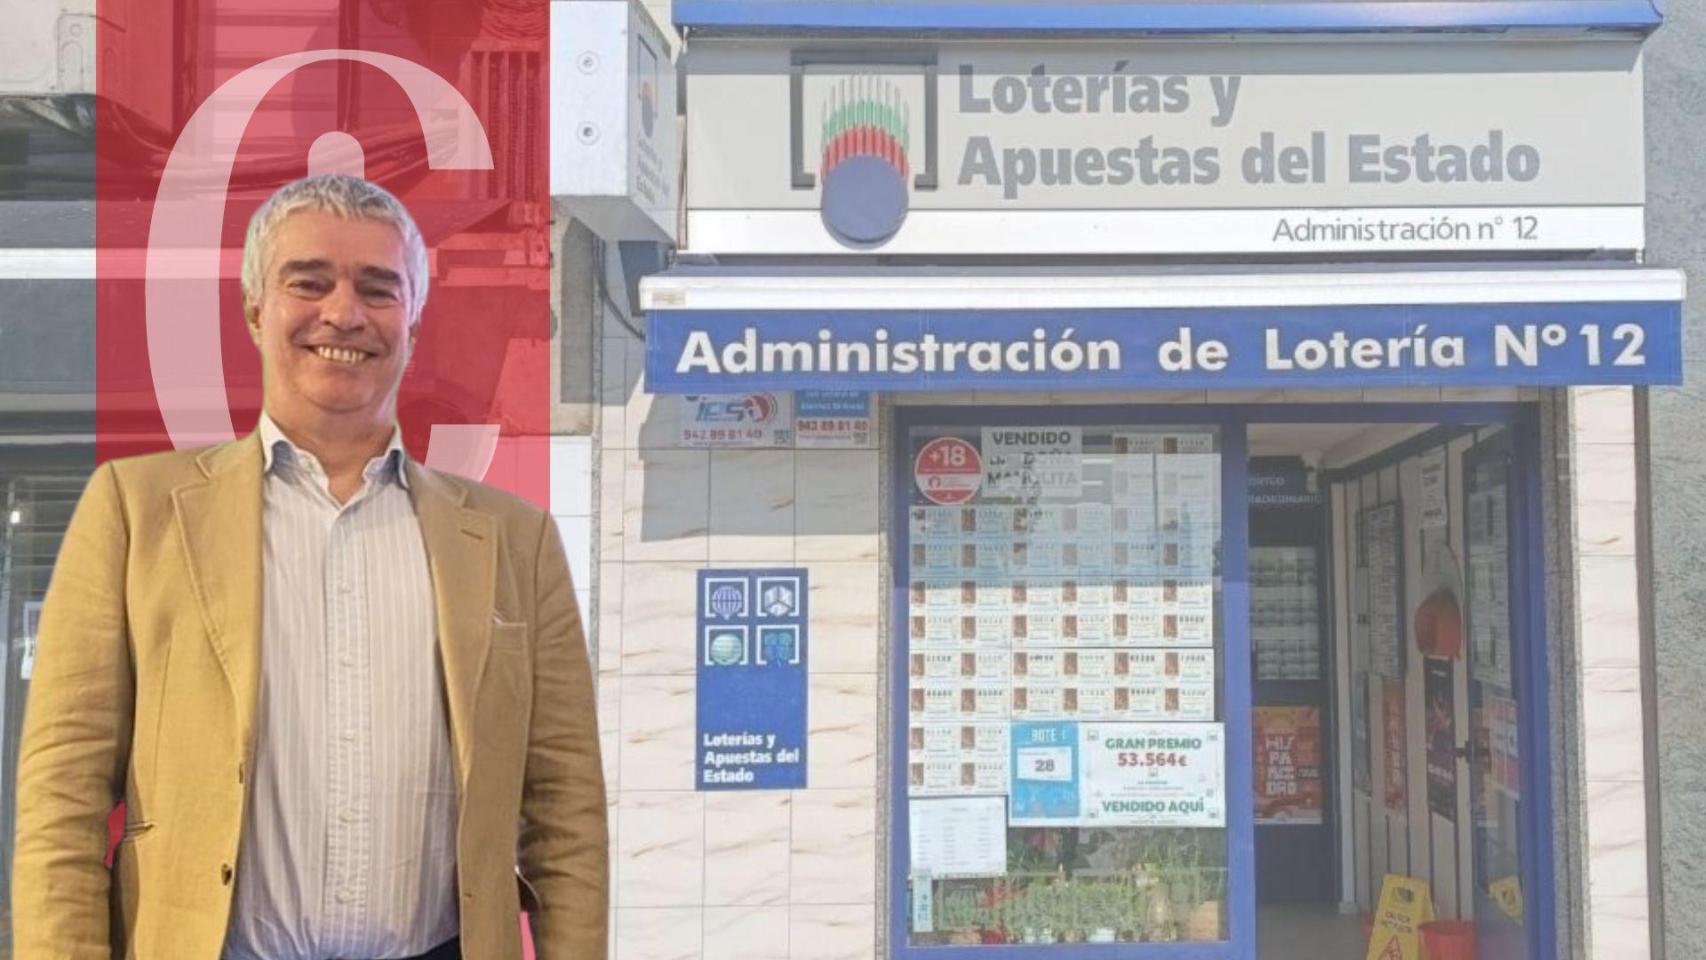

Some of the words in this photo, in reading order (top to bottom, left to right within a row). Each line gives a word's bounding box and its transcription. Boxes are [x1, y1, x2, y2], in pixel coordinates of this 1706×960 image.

[958, 60, 1190, 114] Loterías
[1211, 76, 1241, 127] y
[957, 136, 1220, 199] Apuestas
[1241, 132, 1325, 185] del
[1348, 130, 1541, 184] Estado
[1272, 216, 1471, 243] Administración
[1513, 216, 1539, 241] 12
[676, 327, 1122, 374] Administración
[1158, 328, 1229, 372] de
[1265, 325, 1465, 371] Lotería
[993, 431, 1072, 446] VENDIDO
[929, 446, 966, 467] +18
[703, 732, 763, 747] Loterías
[767, 734, 776, 749] y
[1105, 738, 1145, 750] GRAN
[1148, 738, 1202, 750] PREMIO
[704, 751, 772, 767] Apuestas
[777, 749, 799, 763] del
[703, 769, 754, 783] Estado
[1102, 800, 1166, 812] VENDIDO
[1168, 796, 1204, 814] AQUÍ
